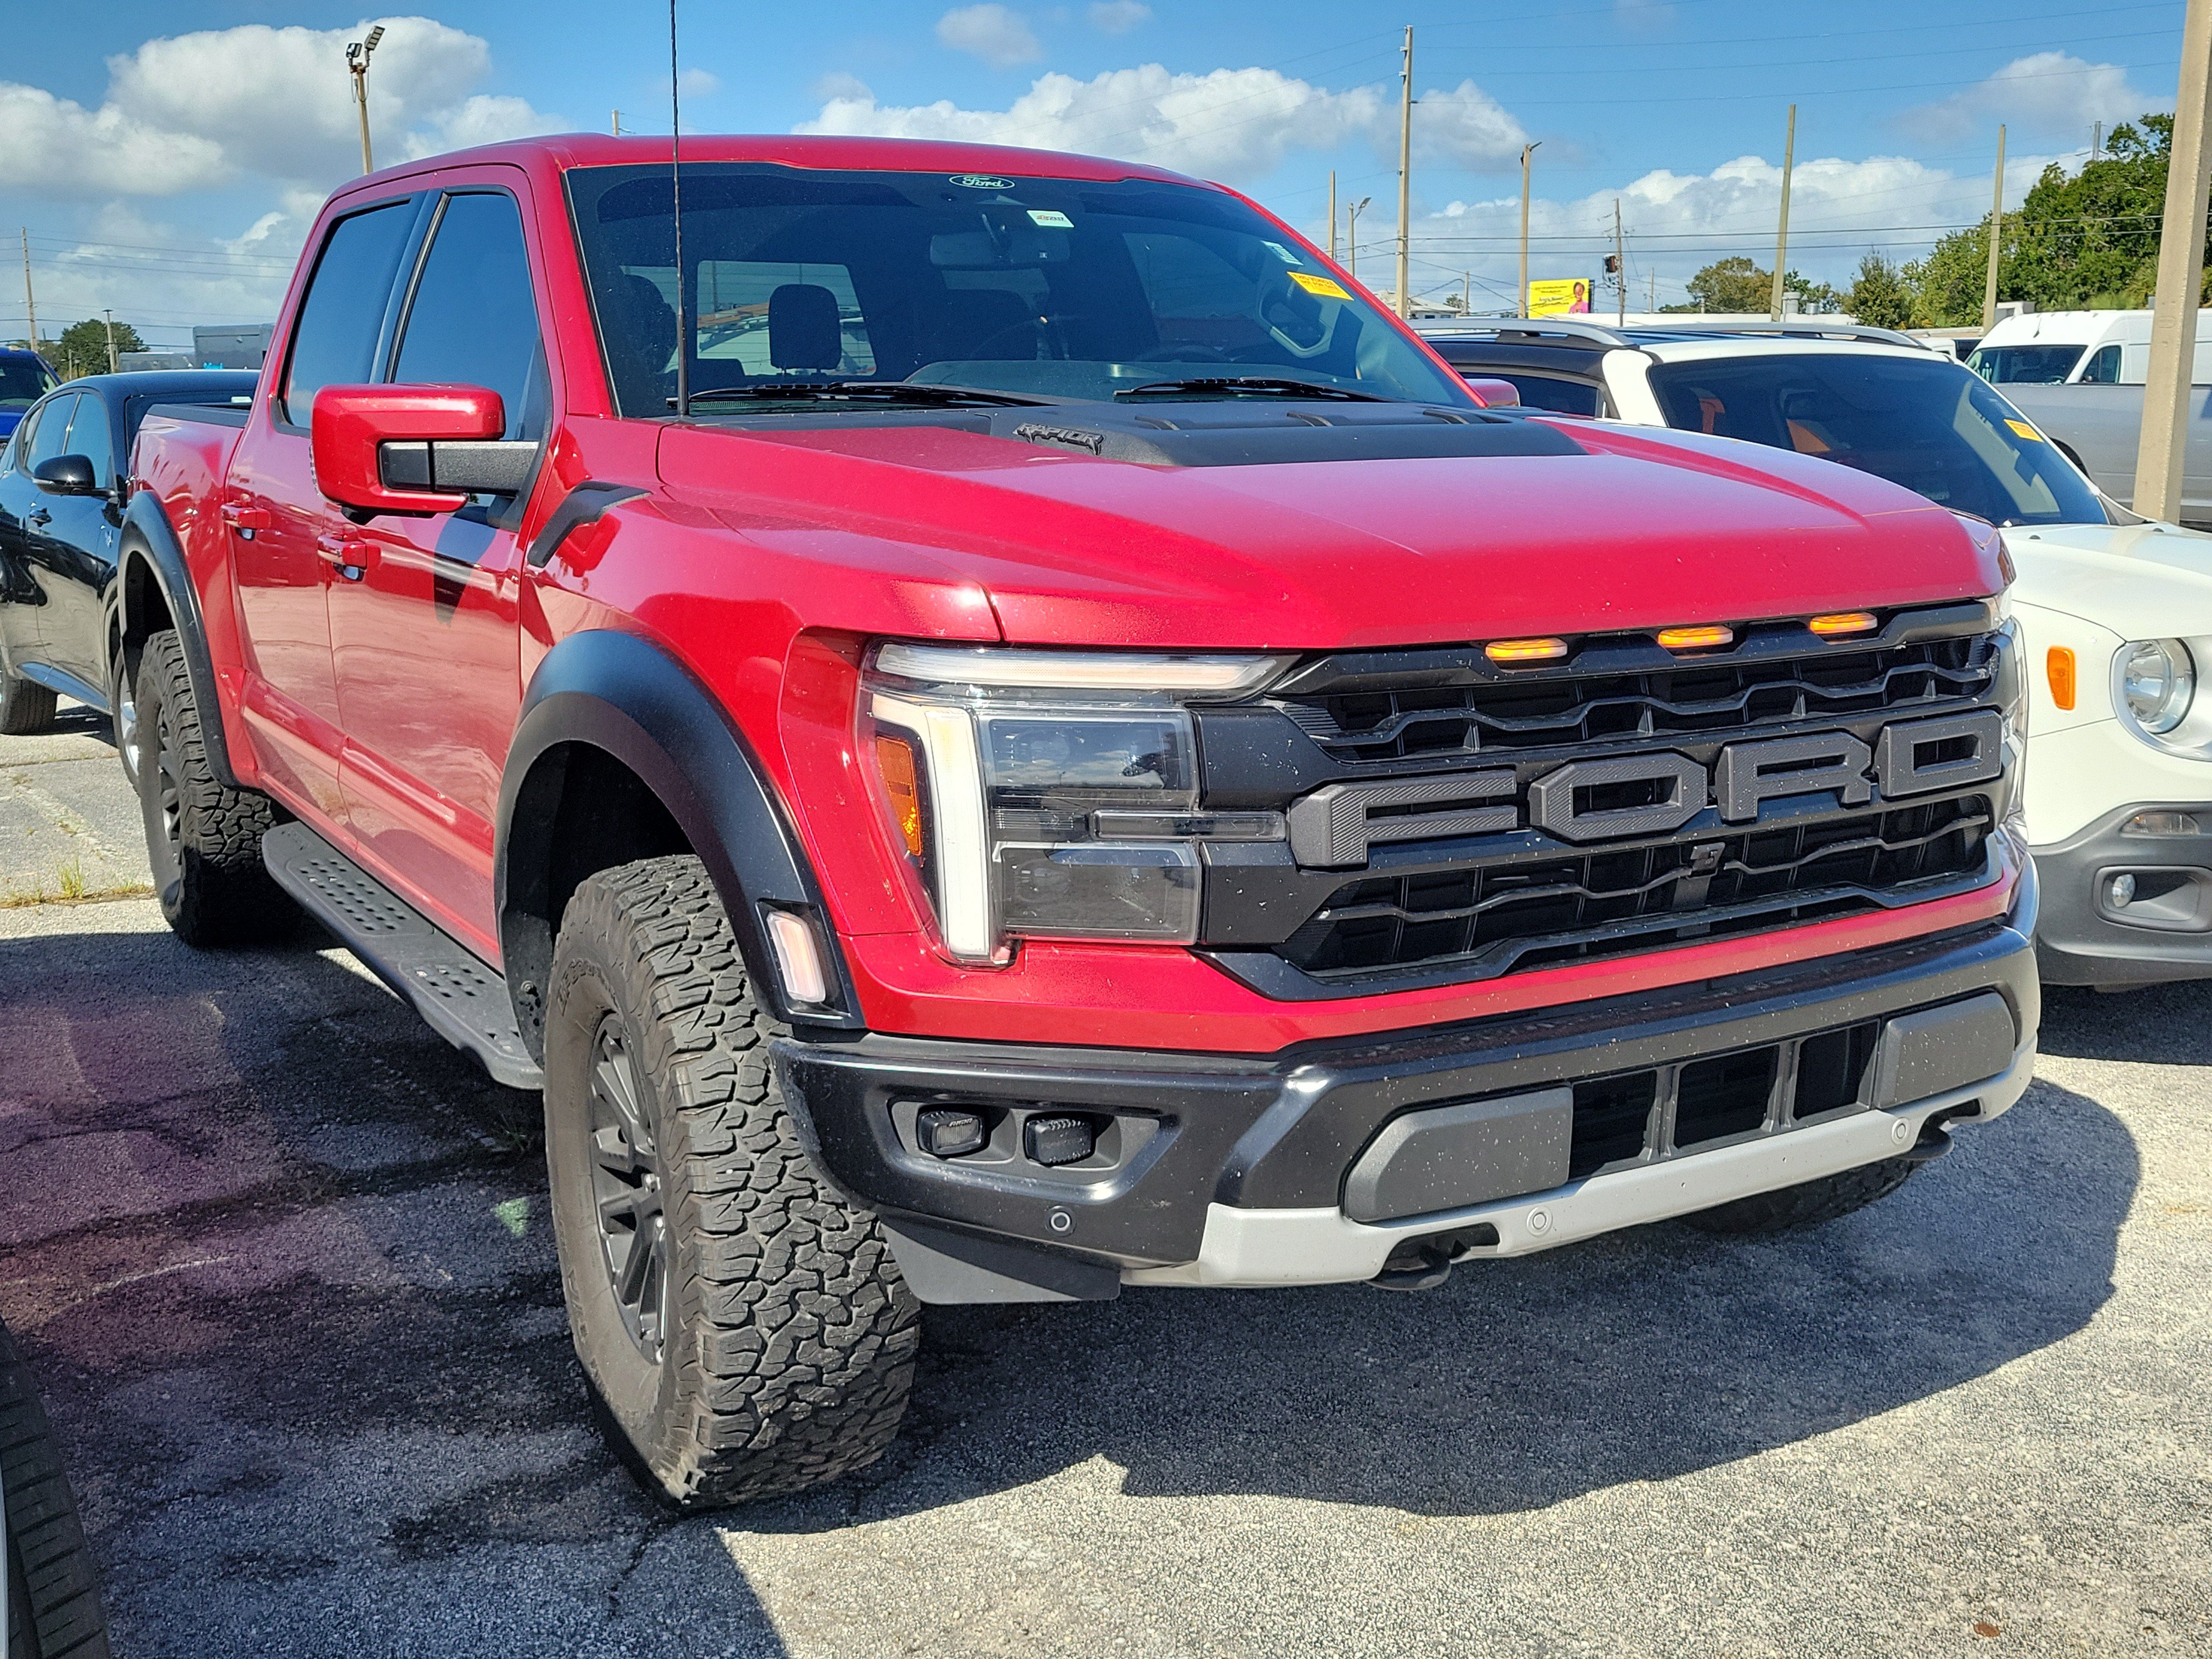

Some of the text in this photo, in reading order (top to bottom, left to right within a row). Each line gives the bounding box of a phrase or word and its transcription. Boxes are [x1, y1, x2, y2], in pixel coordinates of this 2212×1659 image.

[962, 176, 1005, 188] Ford
[1013, 424, 1104, 455] RAPTOR
[1289, 710, 2002, 867] FORD
